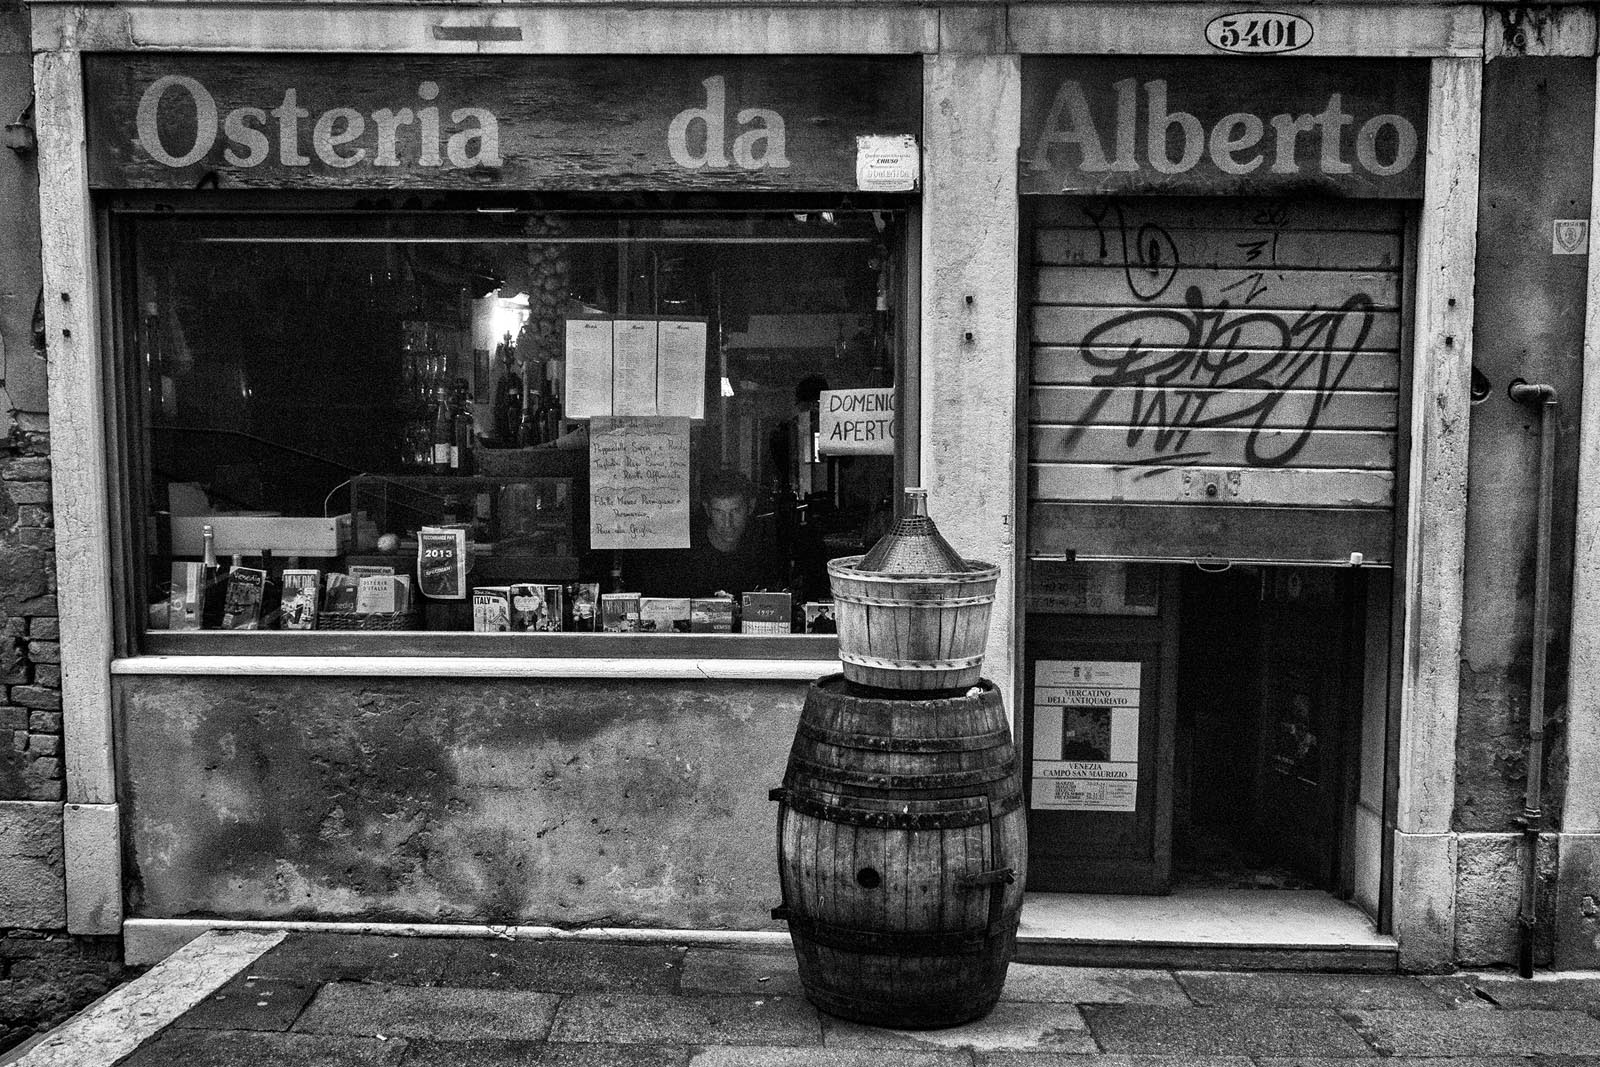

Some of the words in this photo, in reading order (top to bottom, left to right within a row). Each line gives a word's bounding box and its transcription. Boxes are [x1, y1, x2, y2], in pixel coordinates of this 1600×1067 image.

[1220, 19, 1297, 47] 5401
[136, 74, 503, 168] Osteria
[667, 75, 790, 169] da
[1029, 77, 1418, 176] Alberto
[424, 549, 453, 558] 2013
[233, 571, 261, 585] Venedig
[474, 596, 491, 605] ITALY
[1065, 689, 1112, 697] MERCATINO
[1047, 696, 1129, 706] DELL'ANTIQUARIATO
[1043, 769, 1071, 777] CAMPO
[1089, 770, 1128, 778] MAURIZIO
